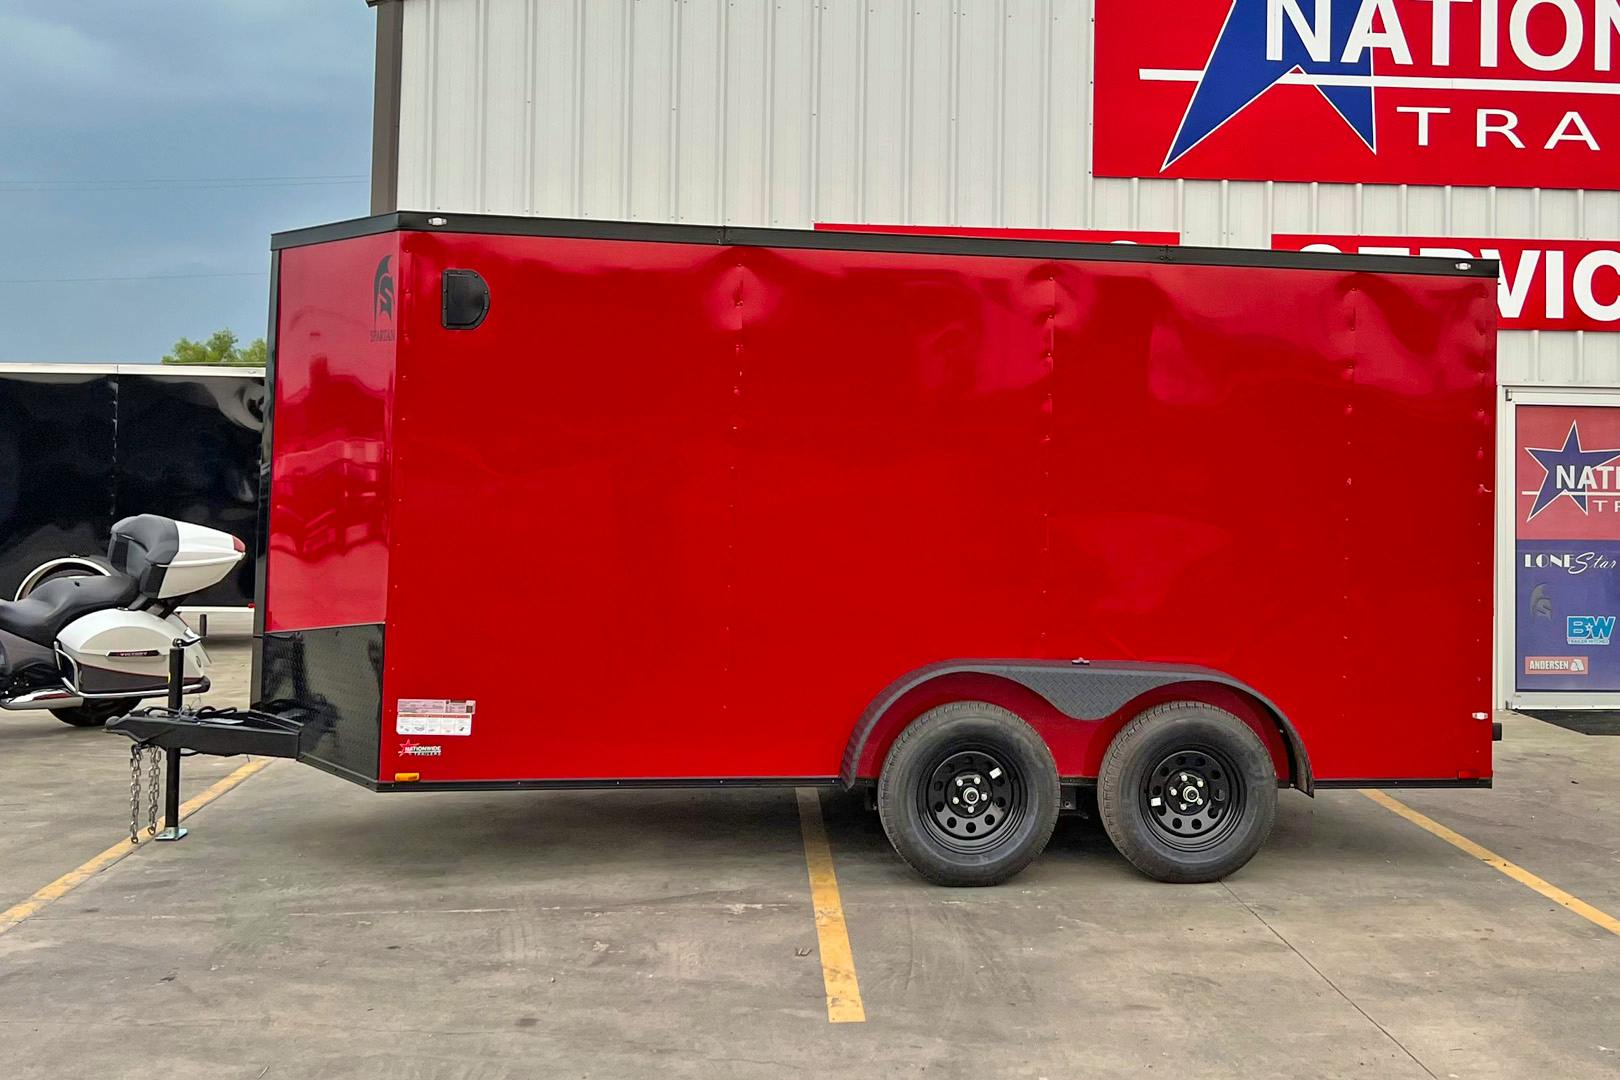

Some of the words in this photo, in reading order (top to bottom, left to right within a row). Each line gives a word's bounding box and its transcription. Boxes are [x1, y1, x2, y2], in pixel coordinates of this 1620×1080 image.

[1397, 106, 1600, 151] TRA
[1525, 554, 1574, 568] LONE
[1568, 552, 1617, 574] Star
[1529, 660, 1569, 670] ANDERSEN
